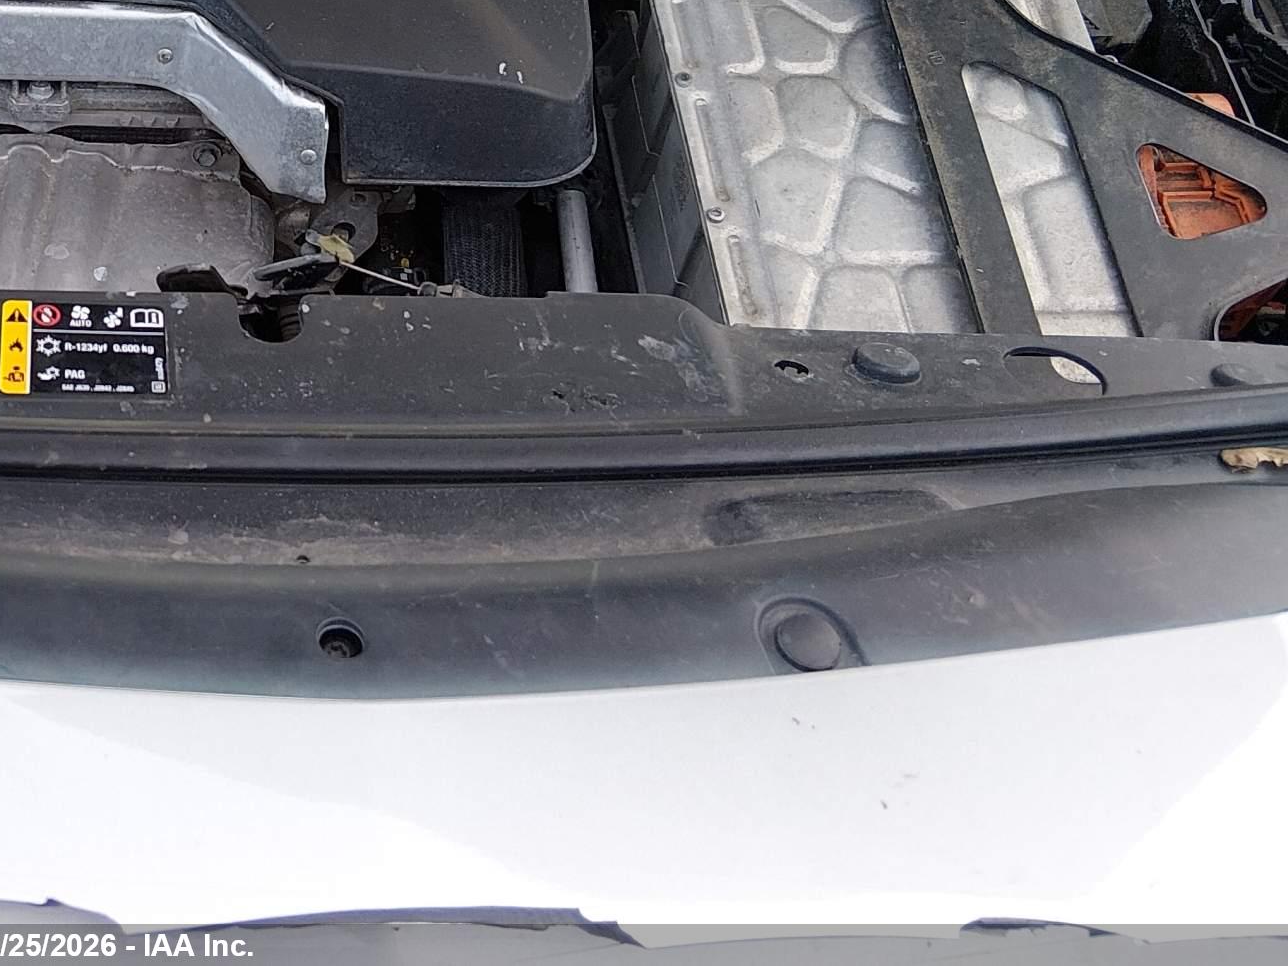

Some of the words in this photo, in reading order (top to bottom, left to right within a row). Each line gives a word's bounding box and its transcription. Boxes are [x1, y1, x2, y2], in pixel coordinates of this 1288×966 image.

[70, 319, 92, 328] AUTO
[64, 343, 108, 354] R-1234yf
[113, 344, 140, 354] 0.600
[141, 344, 155, 355] kg
[64, 369, 86, 380] PAG
